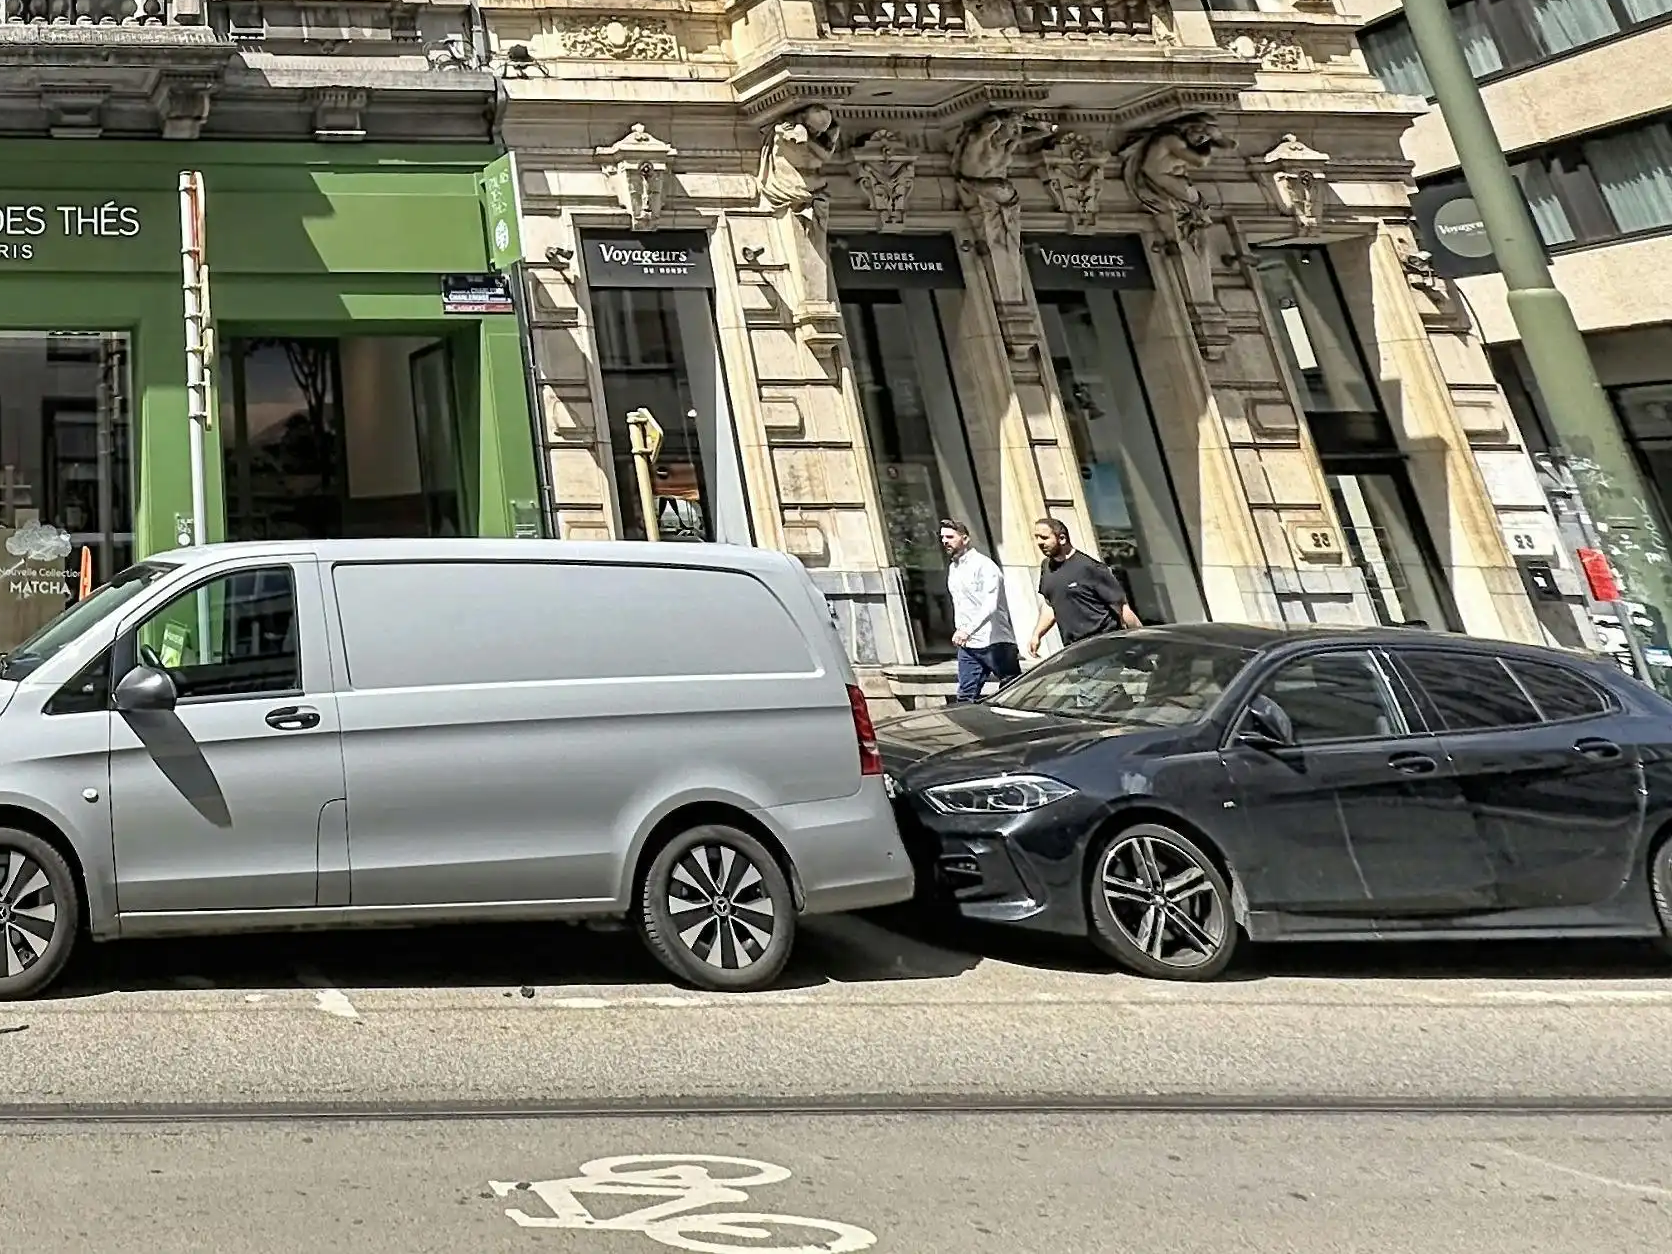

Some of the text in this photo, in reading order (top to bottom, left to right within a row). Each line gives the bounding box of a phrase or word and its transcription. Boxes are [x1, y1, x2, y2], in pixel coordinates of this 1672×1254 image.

[57, 200, 140, 236] THÉS
[1438, 221, 1484, 235] Voyageu
[599, 244, 688, 265] Voyageurs
[872, 252, 915, 261] TERRES
[1040, 248, 1124, 268] Voyageurs
[874, 262, 944, 271] D'AVENTURE
[10, 581, 72, 595] MATCHA
